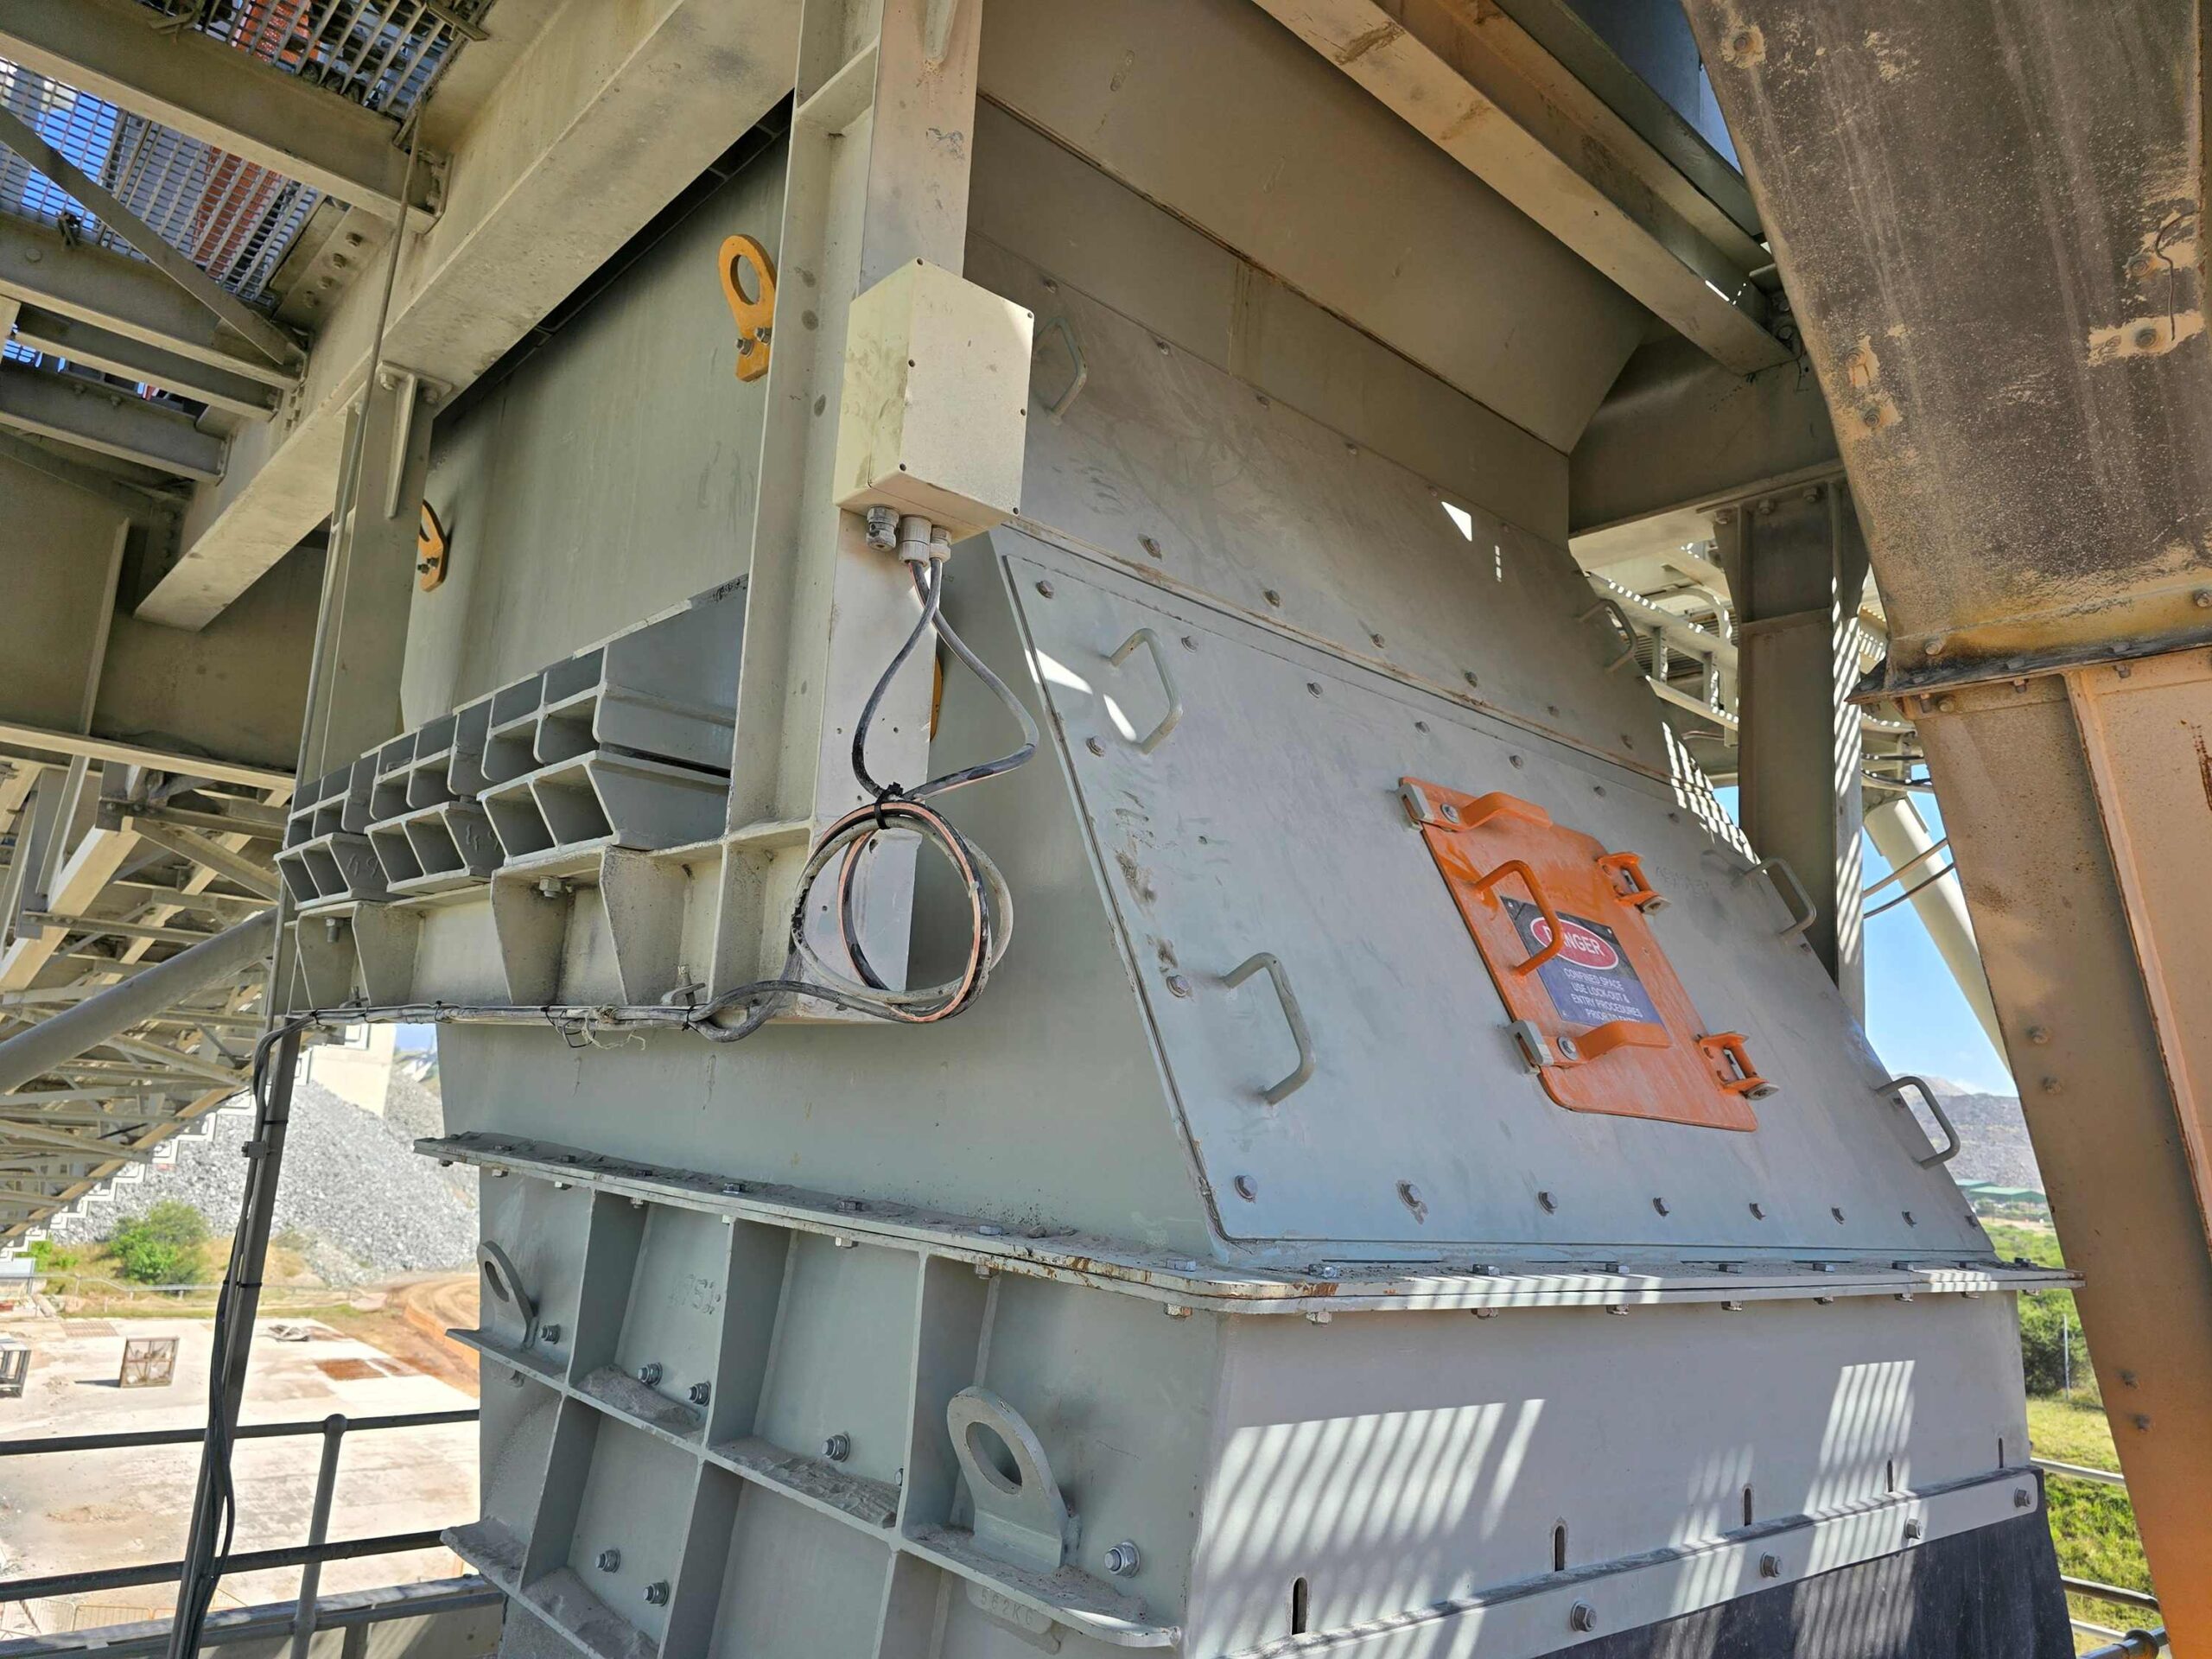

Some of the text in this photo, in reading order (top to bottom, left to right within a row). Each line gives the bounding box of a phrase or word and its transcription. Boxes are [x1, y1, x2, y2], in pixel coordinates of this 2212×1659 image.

[1542, 925, 1605, 957] DNGER
[1563, 968, 1624, 991] CONFINED SPACE
[1571, 982, 1588, 994] USE
[1571, 993, 1643, 1018] ENTRY PROCEDURES
